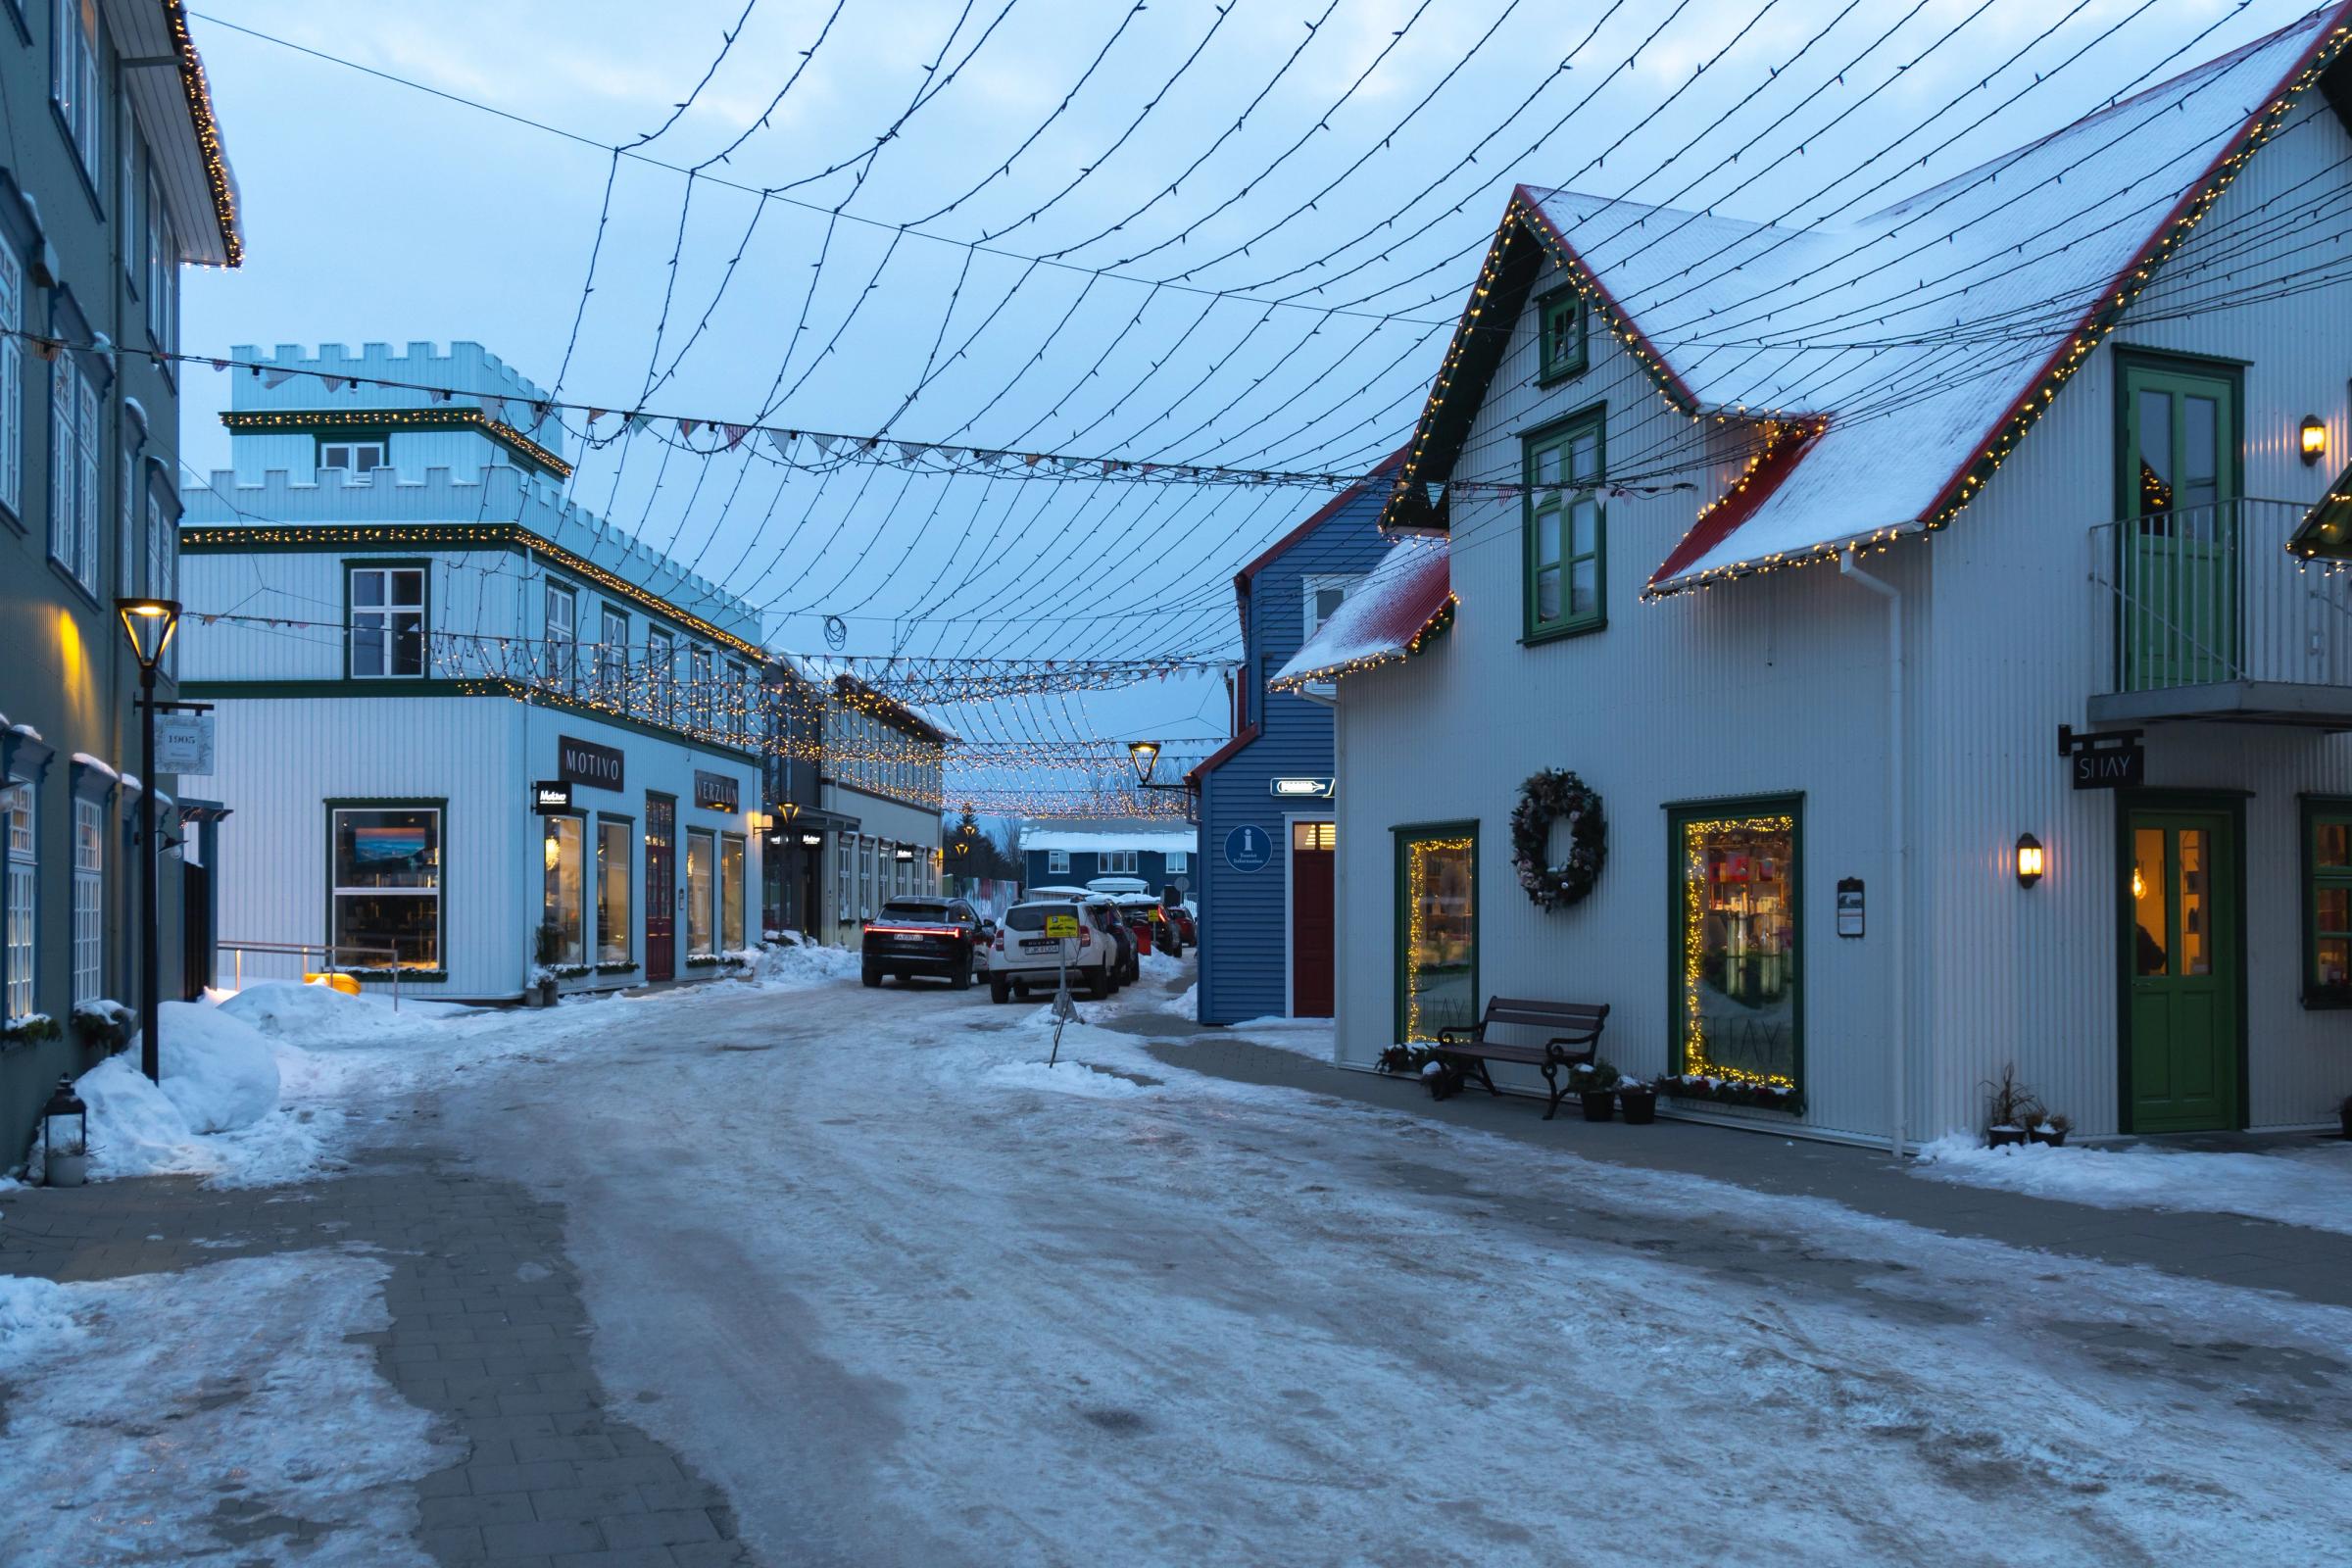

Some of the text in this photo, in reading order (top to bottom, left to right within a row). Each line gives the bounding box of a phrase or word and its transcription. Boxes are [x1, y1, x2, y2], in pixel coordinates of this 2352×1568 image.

[169, 735, 196, 744] 1905
[565, 749, 619, 781] MOTIVO
[540, 790, 566, 801] Motivo
[696, 780, 737, 805] VERZLUN
